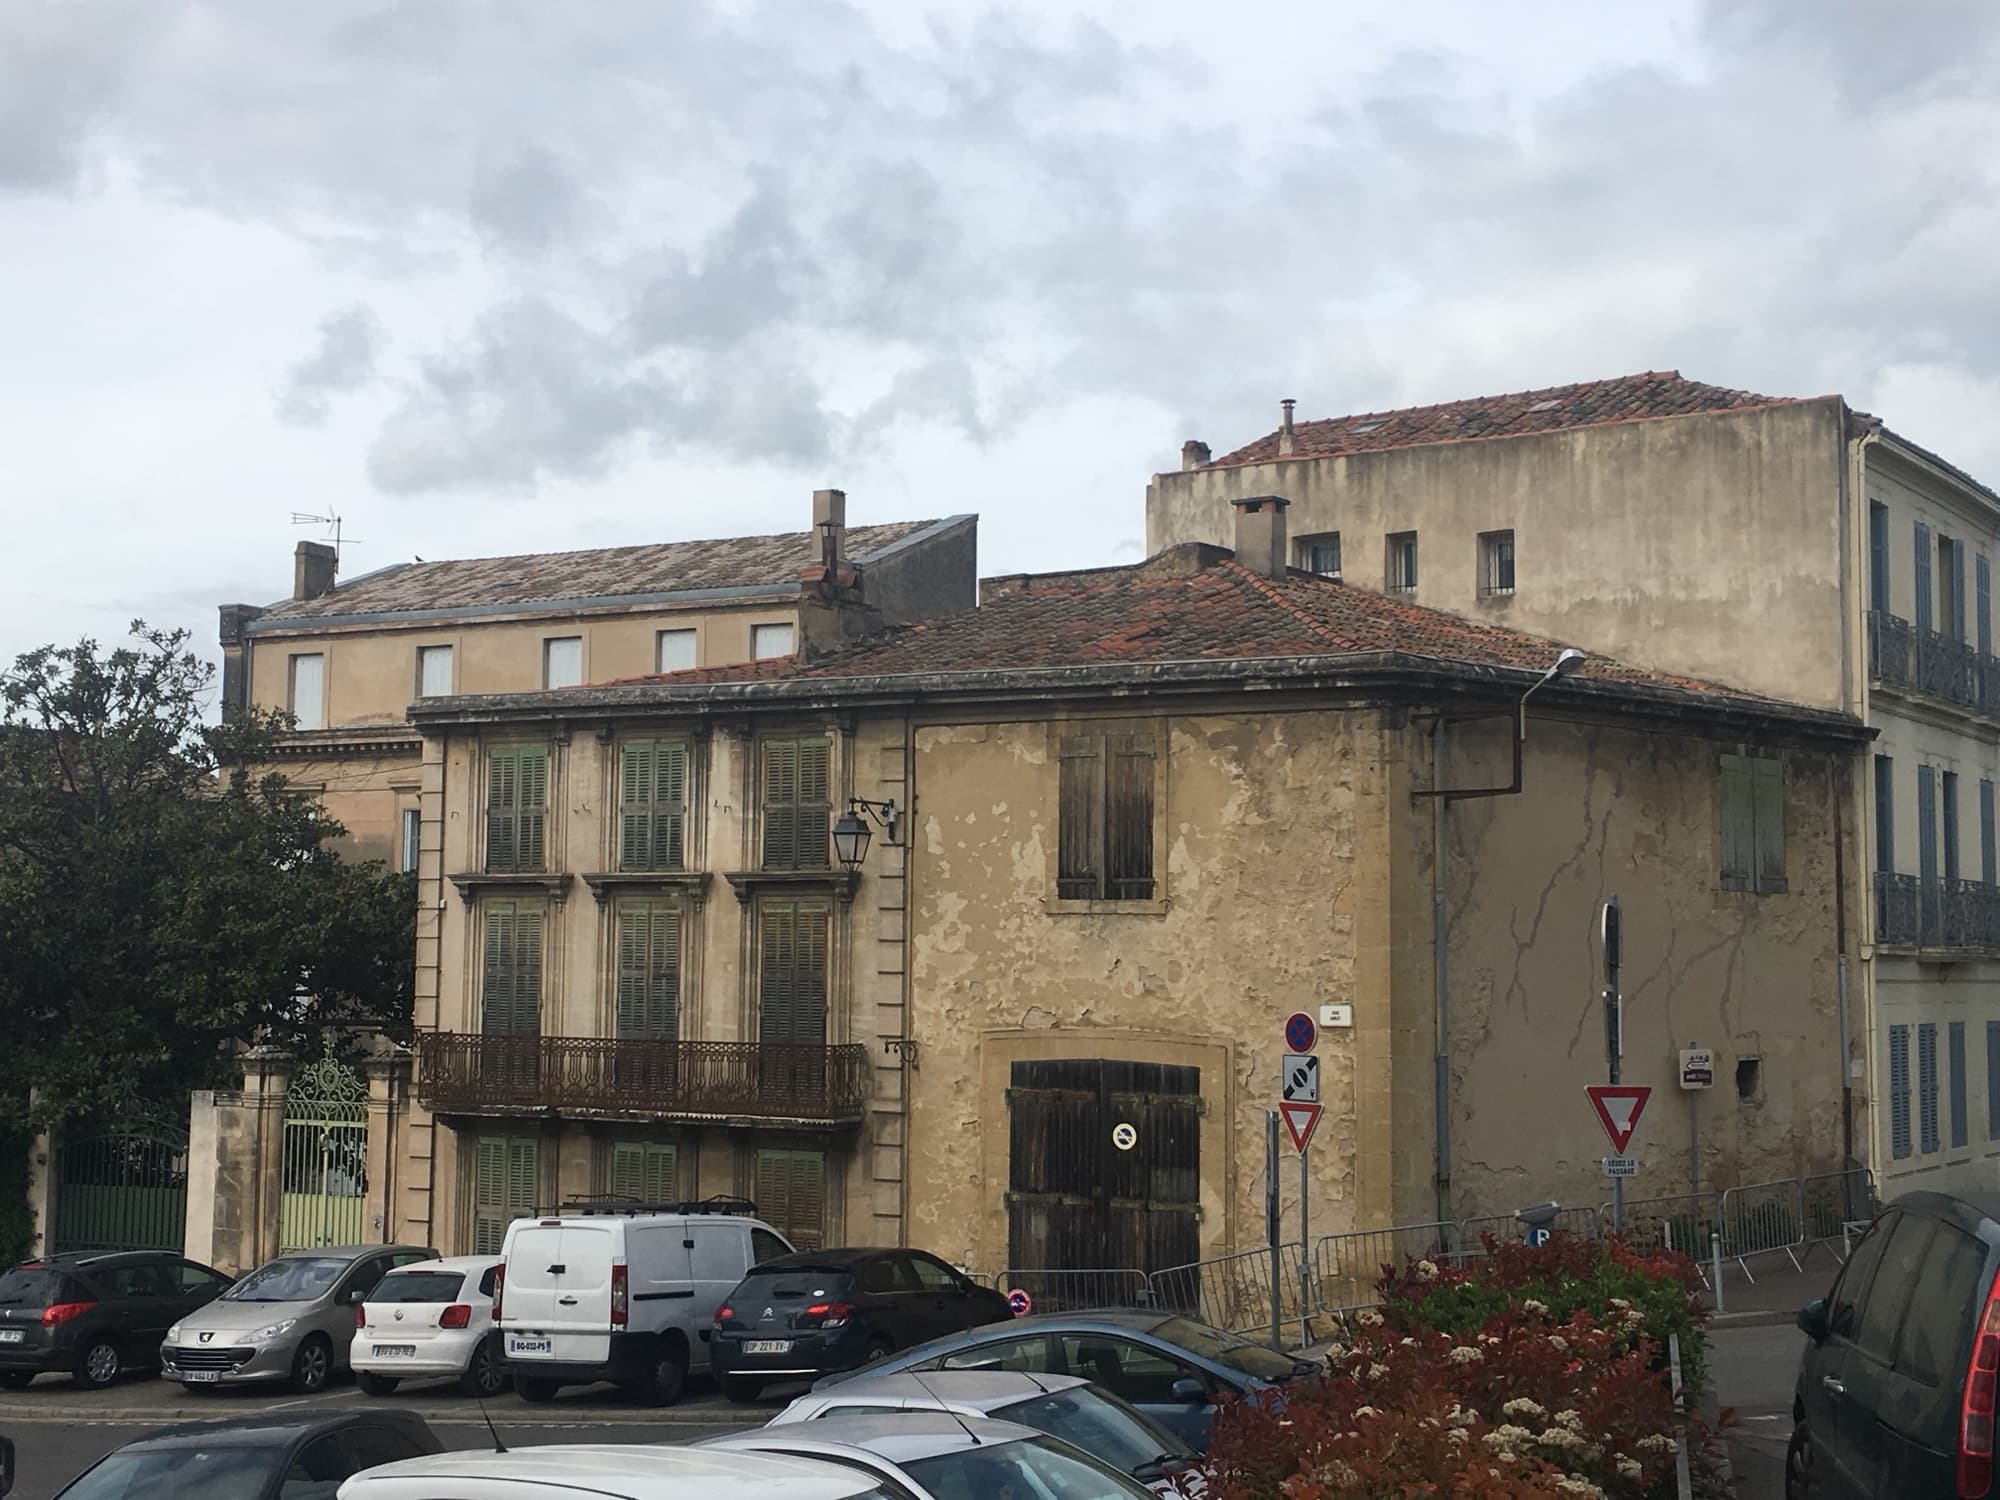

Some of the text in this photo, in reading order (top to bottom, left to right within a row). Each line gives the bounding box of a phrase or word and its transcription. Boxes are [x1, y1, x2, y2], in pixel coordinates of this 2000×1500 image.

[1627, 1159, 1635, 1167] LE
[1608, 1167, 1635, 1175] PASSAGE
[1537, 1229, 1550, 1248] P
[759, 1342, 772, 1351] 221
